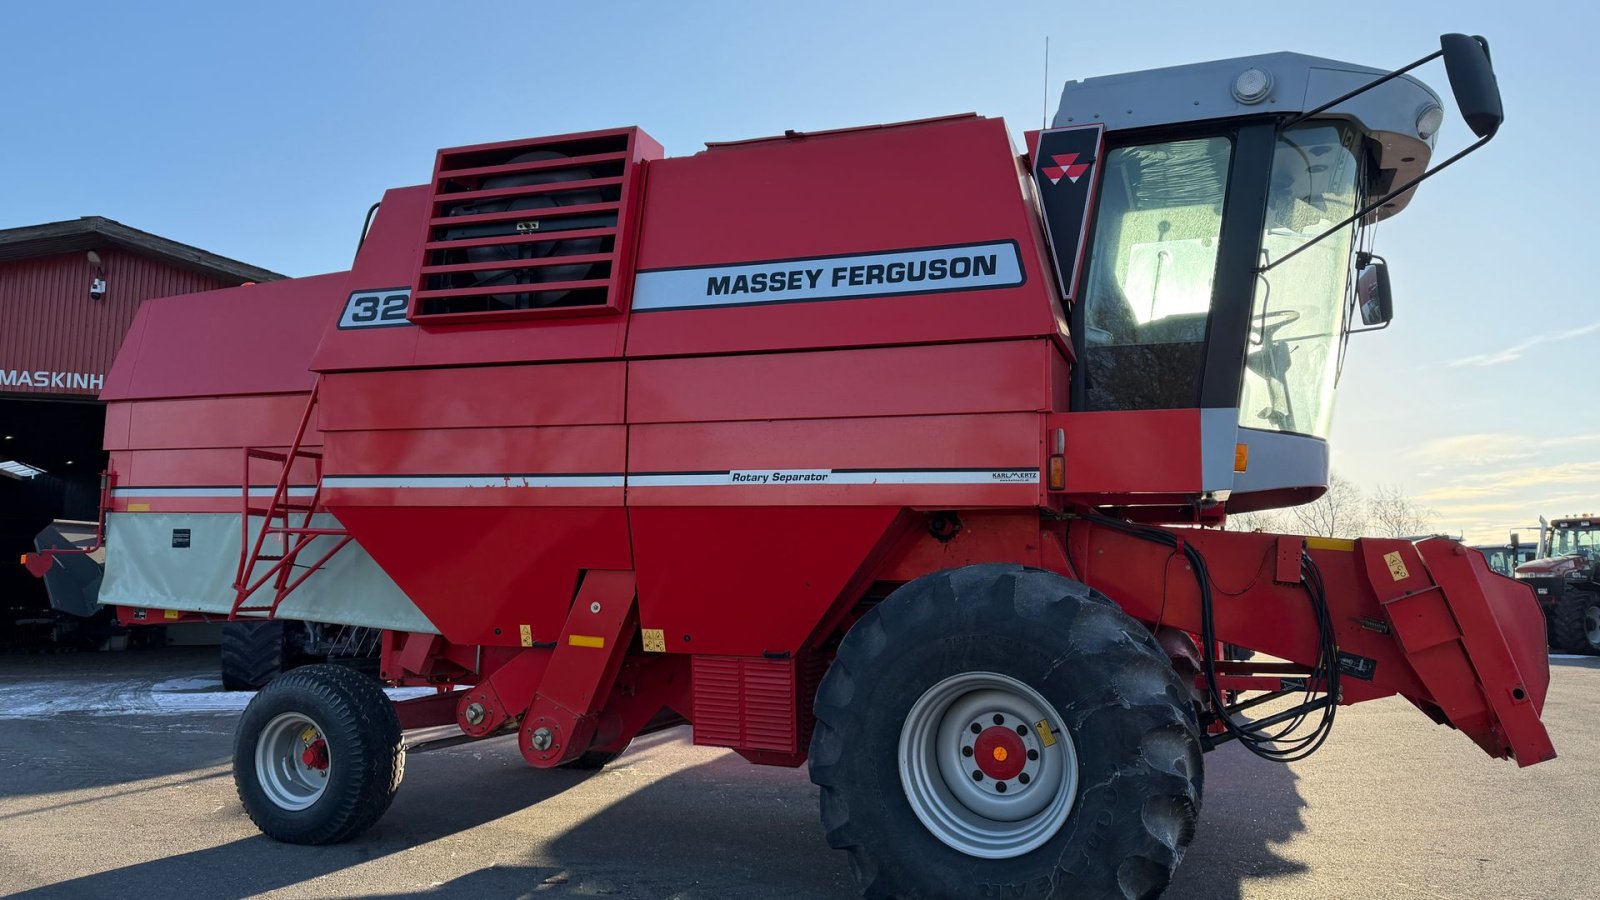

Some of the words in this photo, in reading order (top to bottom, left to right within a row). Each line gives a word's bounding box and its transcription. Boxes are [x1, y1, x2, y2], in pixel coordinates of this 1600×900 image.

[707, 268, 824, 296] MASSEY
[831, 254, 997, 287] FERGUSON
[352, 294, 410, 322] 32
[0, 369, 104, 390] MASKINH
[732, 472, 769, 484] Rotary
[772, 472, 828, 483] Separator
